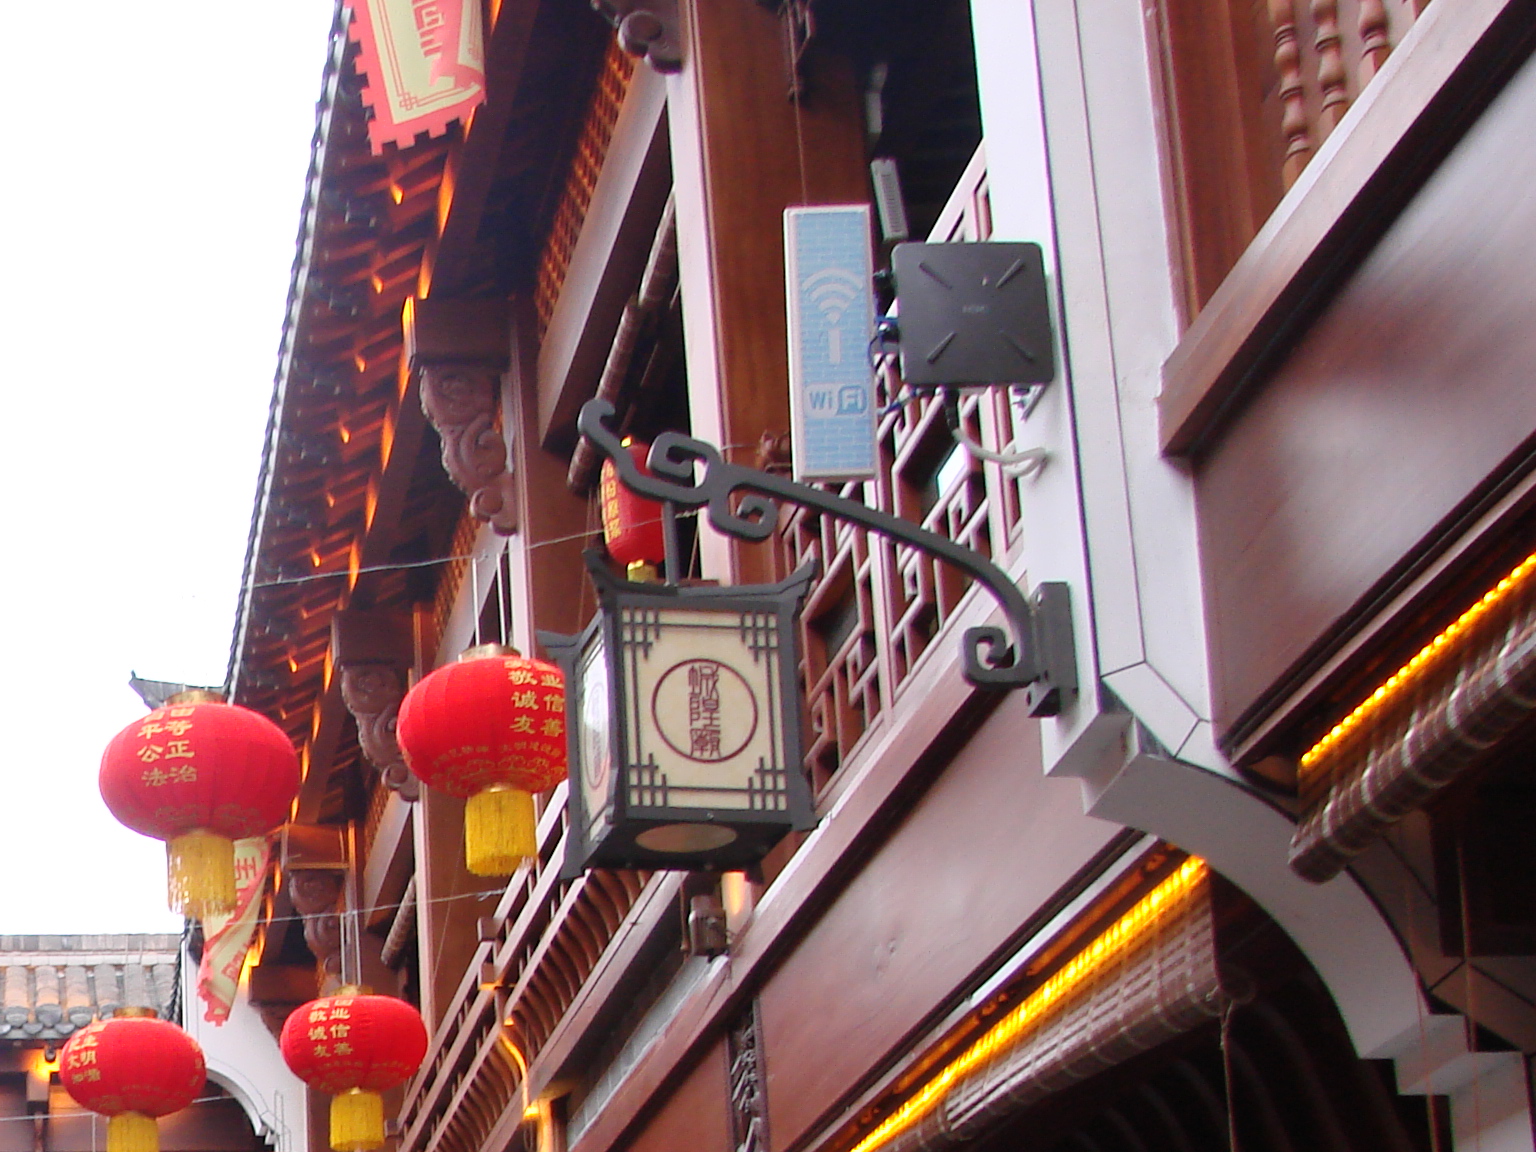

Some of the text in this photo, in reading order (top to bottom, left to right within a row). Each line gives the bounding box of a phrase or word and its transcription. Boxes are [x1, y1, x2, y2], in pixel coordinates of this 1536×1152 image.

[508, 670, 565, 690] 敬业
[511, 690, 566, 713] 诚信
[137, 720, 193, 739] 平等
[509, 714, 564, 738] 友善
[137, 740, 195, 763] 公正
[141, 765, 197, 787] 法治
